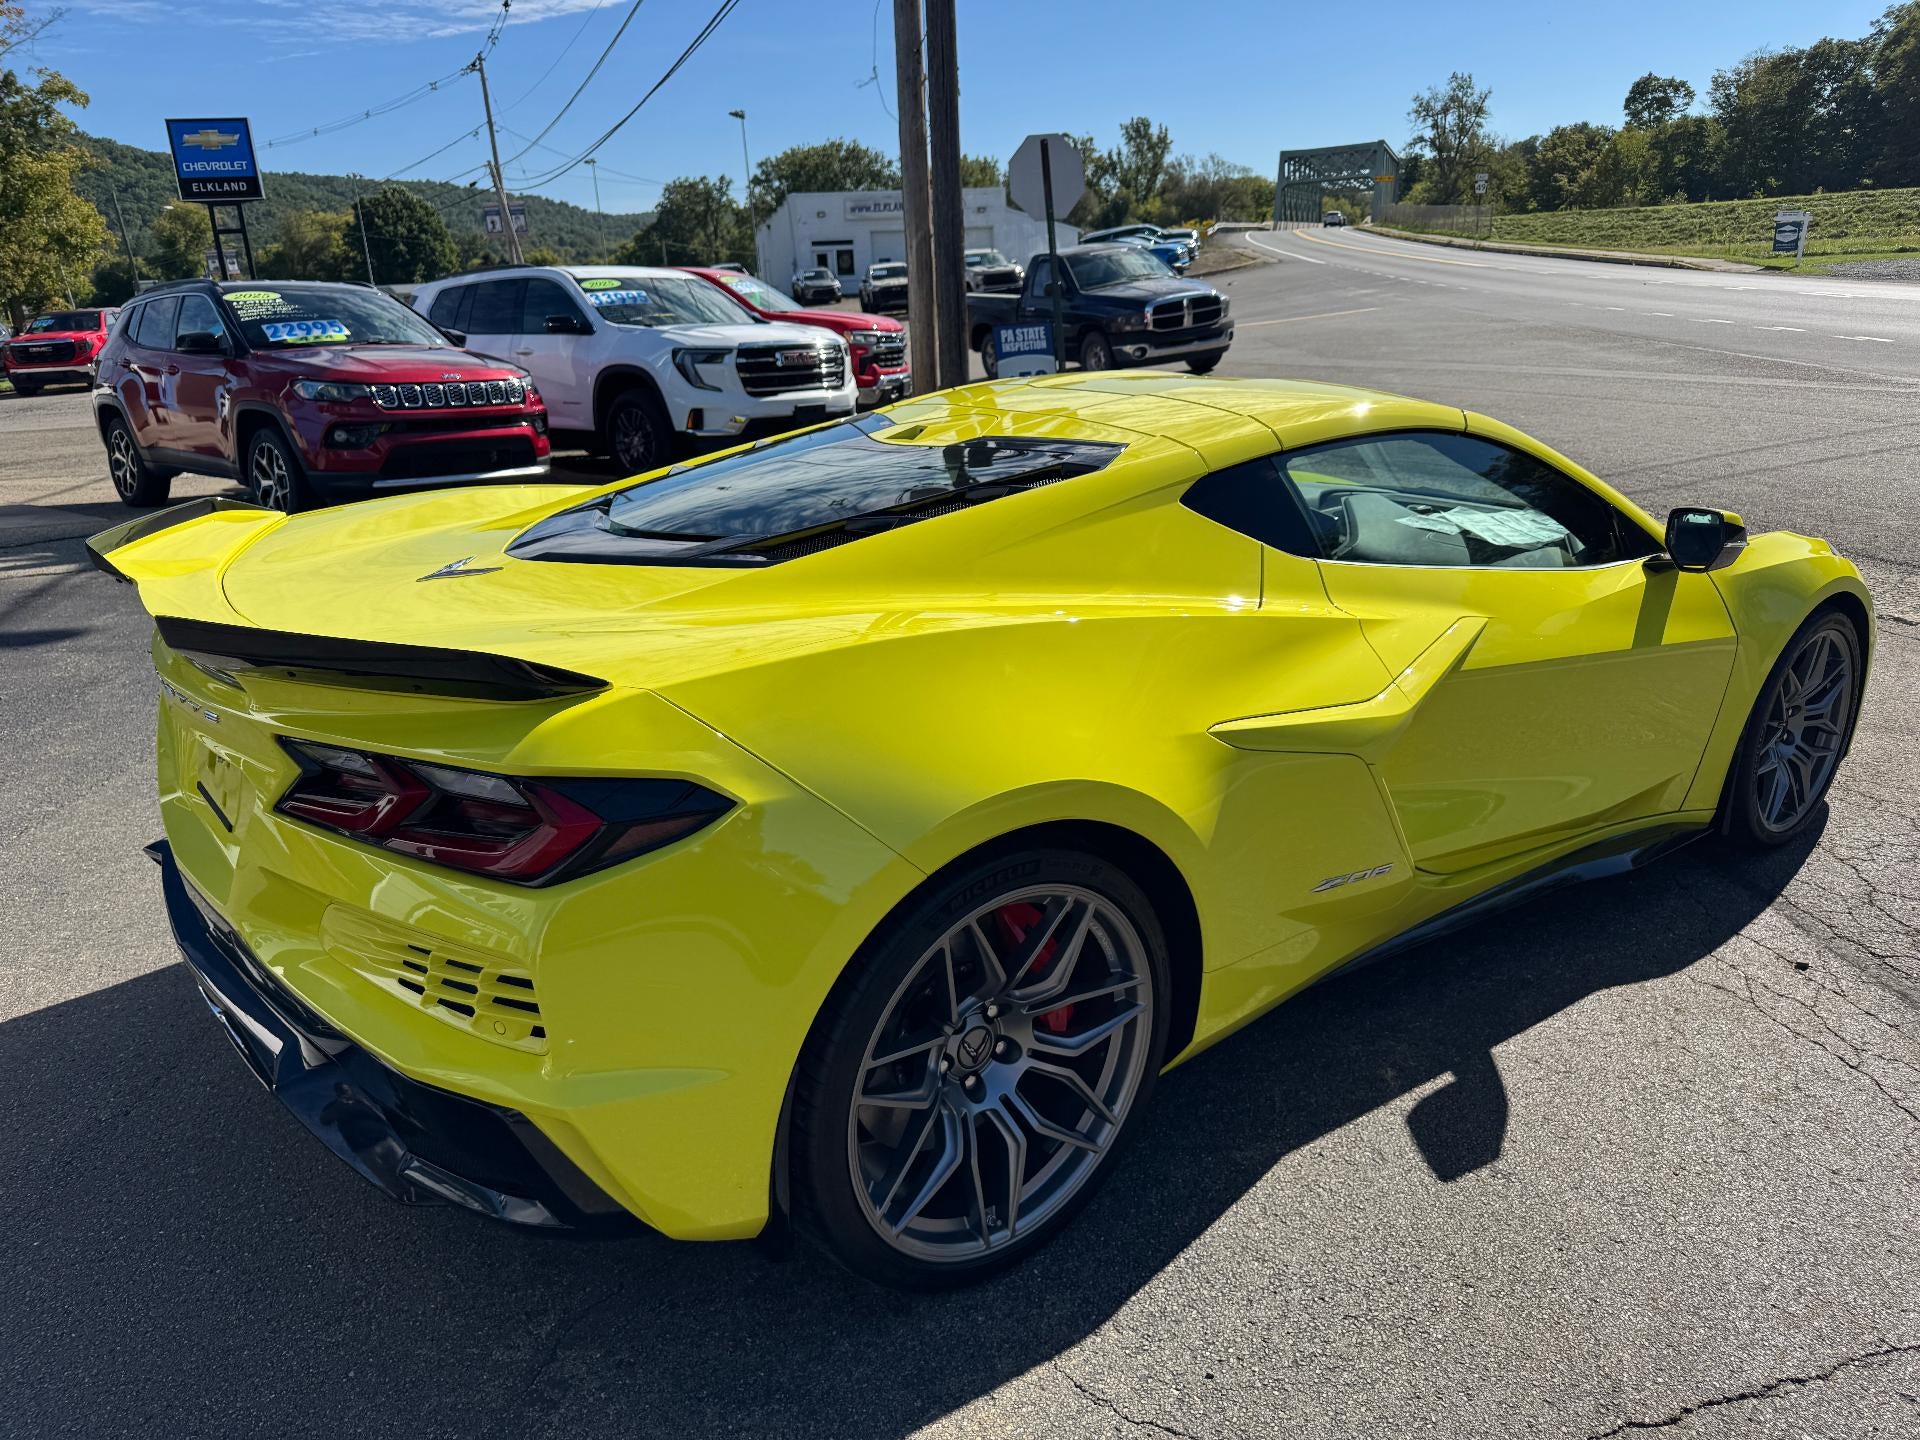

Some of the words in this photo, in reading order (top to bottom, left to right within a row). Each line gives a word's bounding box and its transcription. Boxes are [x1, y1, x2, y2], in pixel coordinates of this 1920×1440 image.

[182, 161, 248, 172] CHEVROLET
[192, 182, 247, 192] ELKLAND
[234, 291, 270, 299] 2025
[590, 291, 647, 306] 33995
[265, 320, 344, 339] 22995
[1000, 329, 1015, 343] PA
[1015, 326, 1046, 341] STATE
[1002, 340, 1047, 352] INSPECTION
[1311, 862, 1394, 893] Z06
